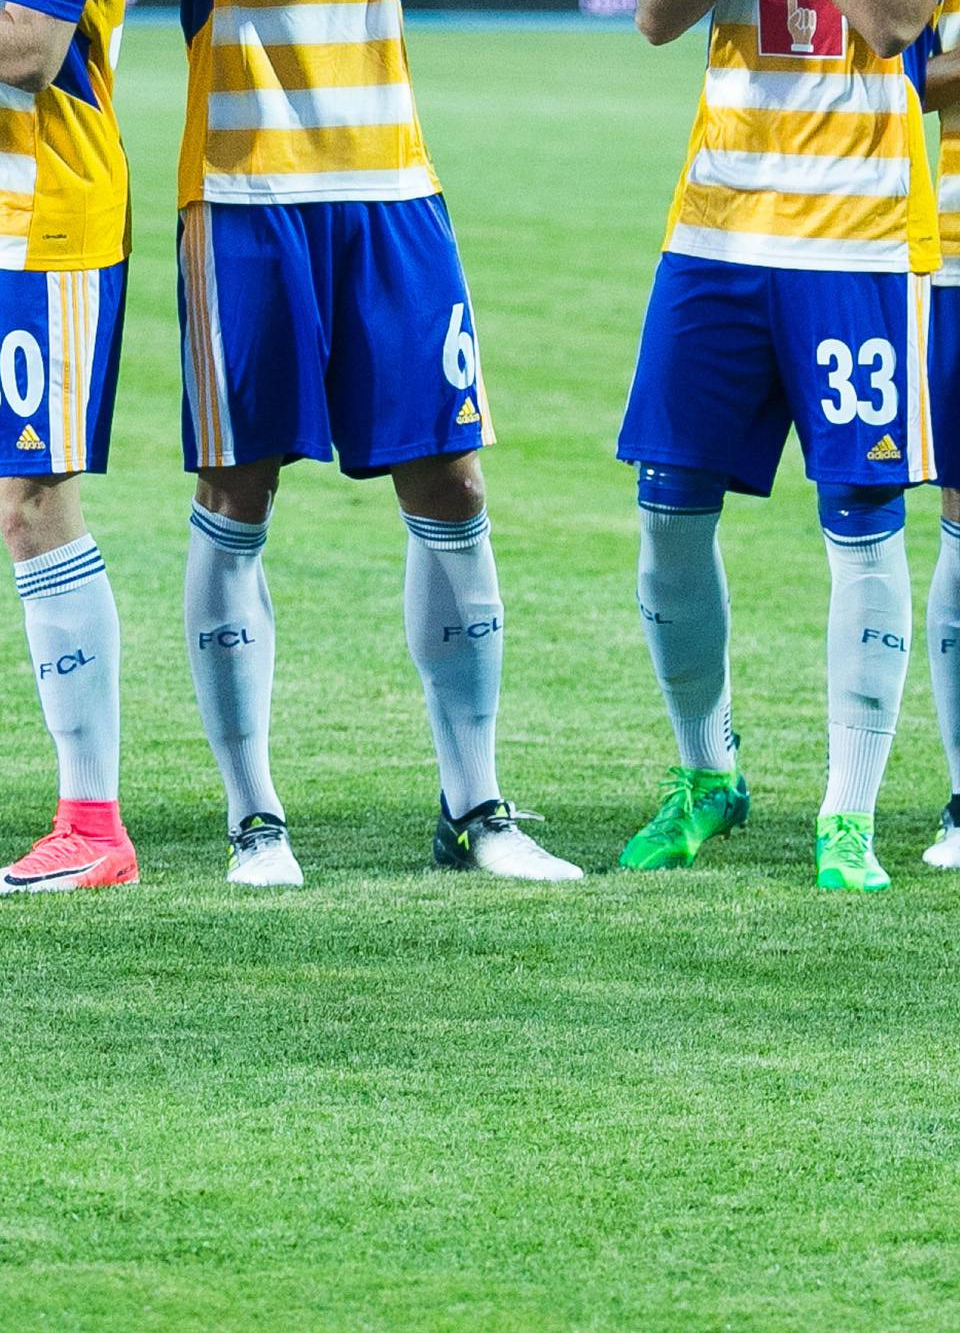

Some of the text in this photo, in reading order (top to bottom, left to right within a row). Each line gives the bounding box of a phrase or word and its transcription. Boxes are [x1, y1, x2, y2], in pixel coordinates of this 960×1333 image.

[443, 303, 475, 390] 6
[816, 338, 899, 426] 33
[639, 604, 674, 626] CL
[198, 628, 255, 650] FCL
[443, 617, 502, 643] FCL
[861, 628, 906, 653] FCL
[36, 648, 95, 680] FCL
